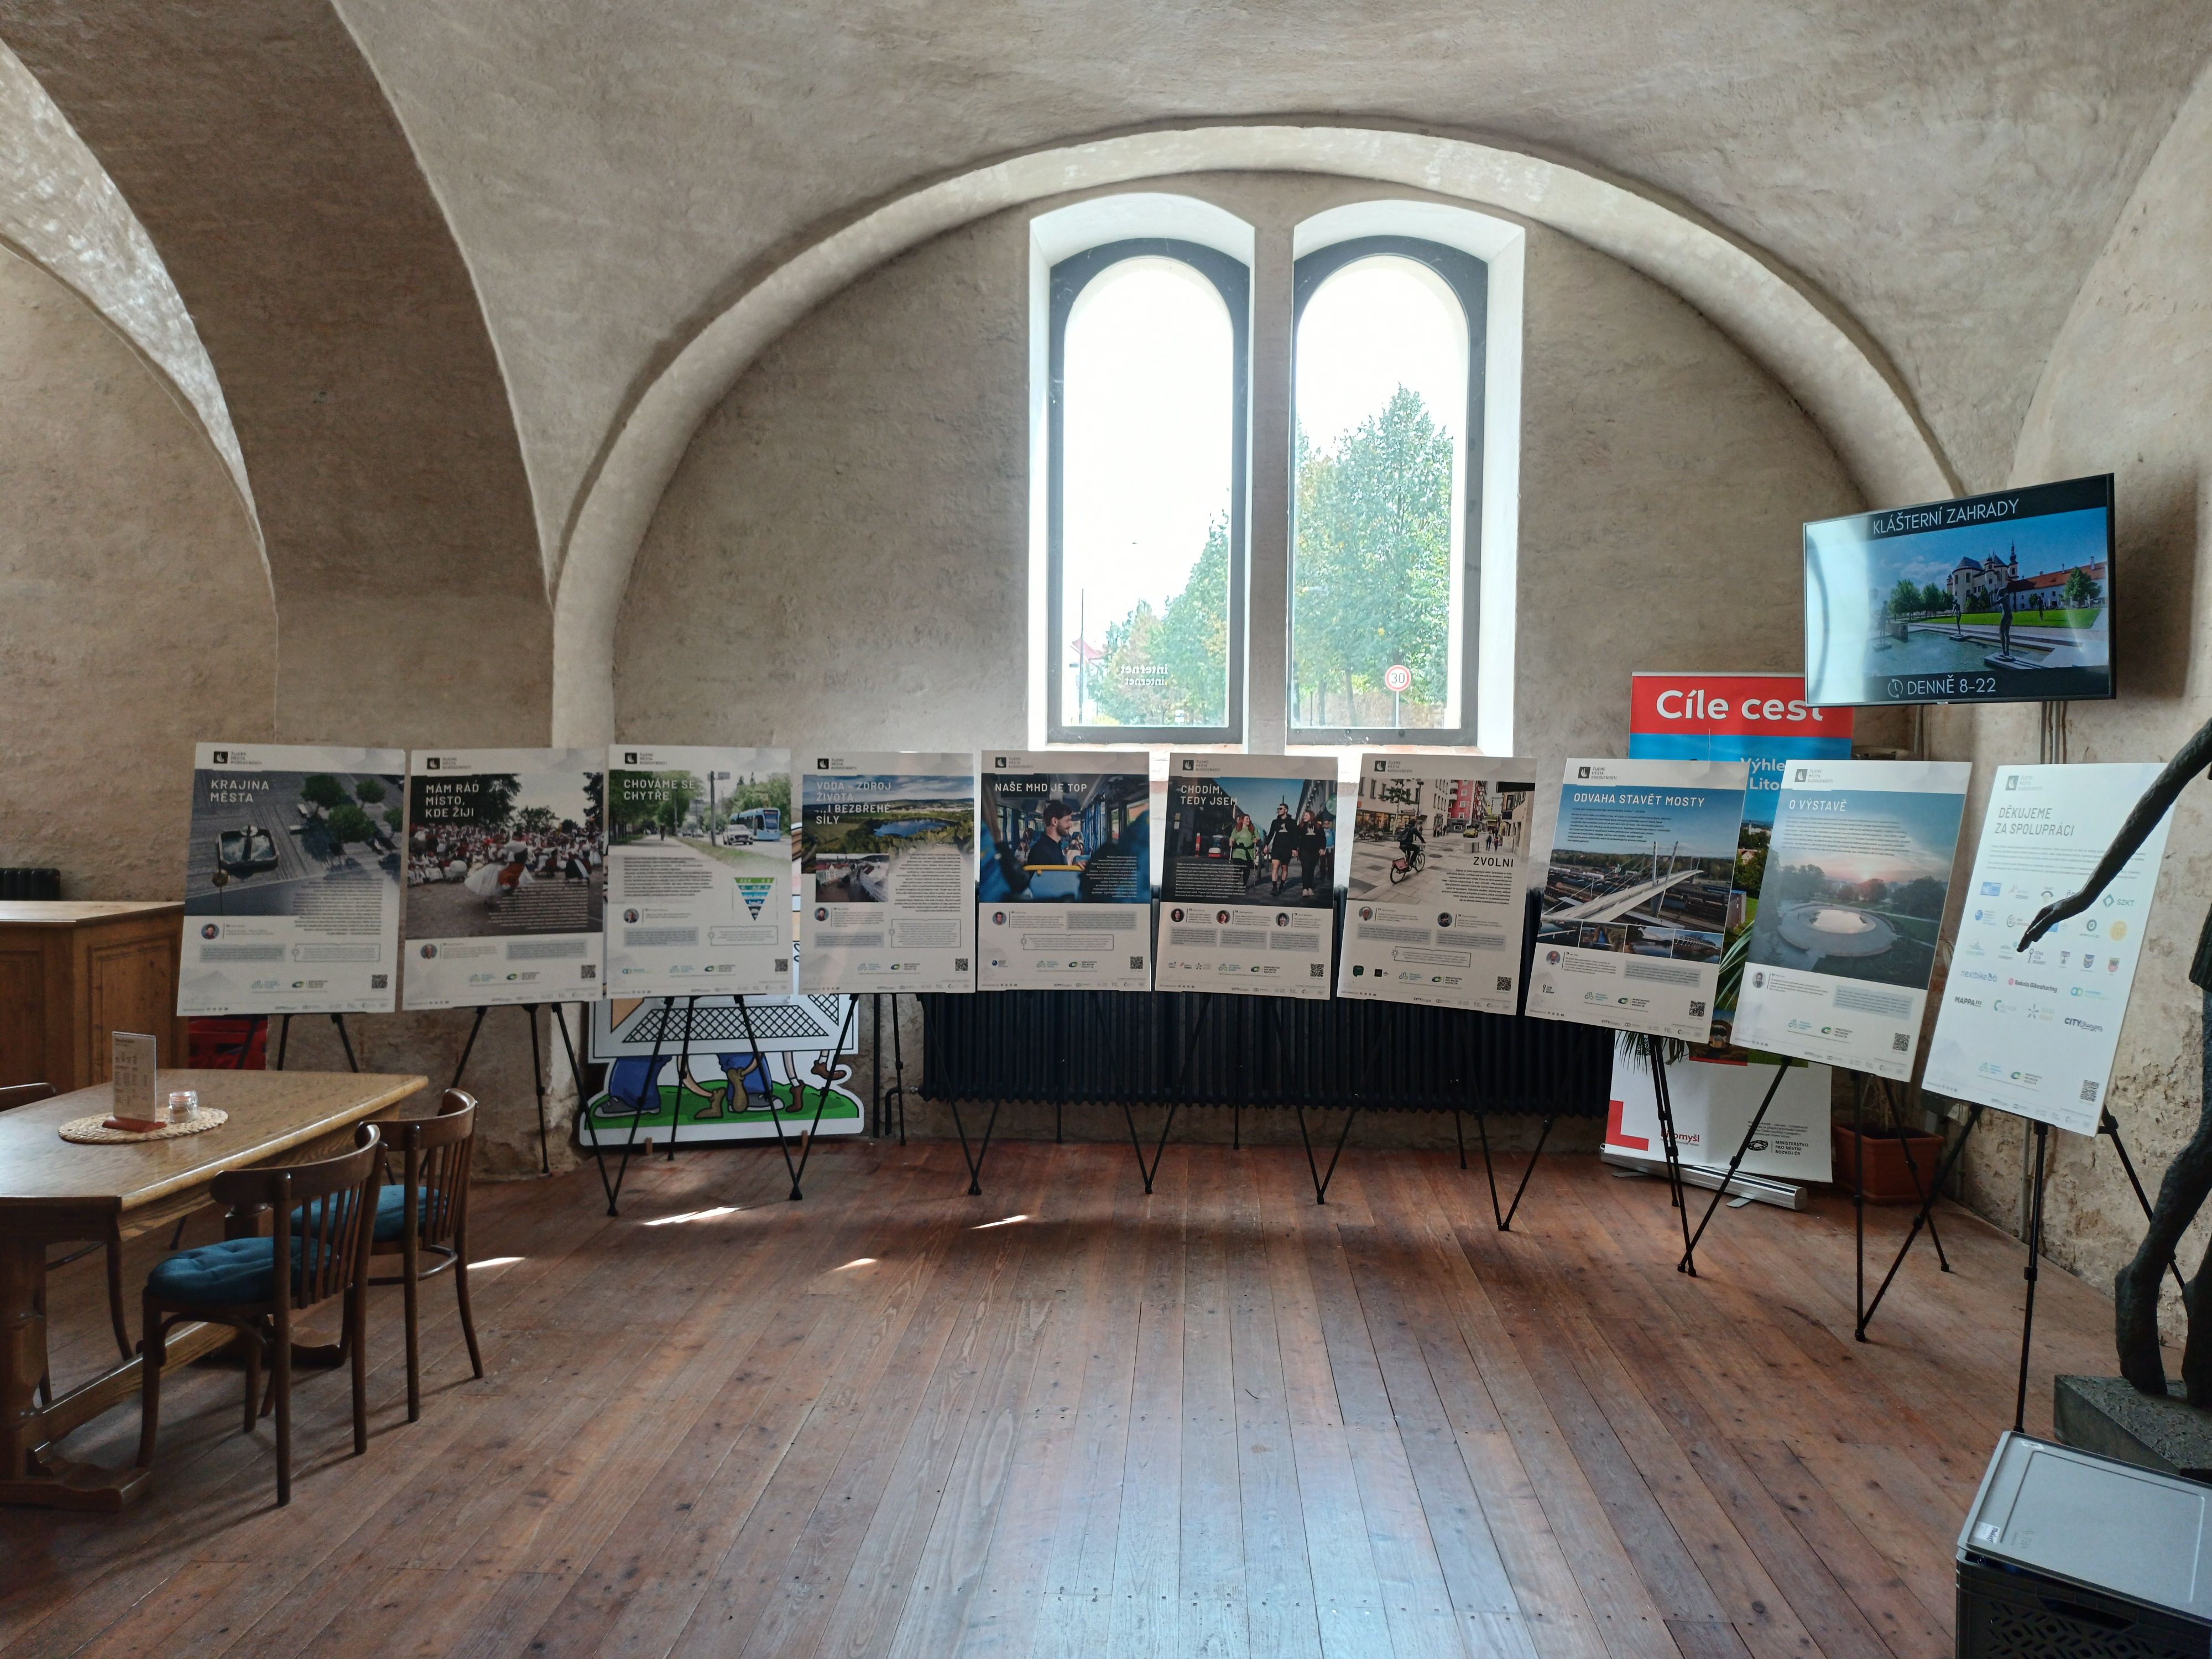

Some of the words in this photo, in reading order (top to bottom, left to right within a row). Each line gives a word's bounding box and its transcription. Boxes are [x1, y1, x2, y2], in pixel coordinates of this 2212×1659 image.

[1874, 506, 1943, 535] KLÁŠTERNÍ
[1947, 498, 2019, 524] ZAHRADY
[1391, 672, 1405, 684] 30
[1908, 674, 1954, 695] DENNĚ
[1960, 677, 1996, 693] 8-22
[1656, 689, 1729, 719] Cíle
[1740, 758, 1785, 774] ýhle
[211, 779, 269, 790] KRAJINA
[426, 782, 451, 794] MÁM
[456, 781, 479, 793] RÁD
[624, 777, 677, 789] CHOVÁME
[681, 780, 696, 789] SE
[817, 781, 844, 790] VODA
[857, 781, 891, 791] ZDROJ
[995, 781, 1022, 792] NAŠE
[1026, 783, 1048, 792] MHD
[1051, 783, 1063, 792] JE
[1068, 783, 1087, 792] TOP
[1749, 778, 1782, 791] Lito
[624, 789, 669, 801] CHYTŘE
[1181, 784, 1223, 795] CHODÍM,
[210, 790, 253, 802] MĚSTA
[426, 794, 465, 806] MÍSTO,
[1181, 796, 1208, 805] TEDY
[1210, 796, 1238, 806] JSEM
[1574, 792, 1615, 804] ODVAHA
[1619, 793, 1662, 805] STAVĚT
[1665, 796, 1705, 807] MOSTY
[834, 802, 891, 813] BEZBŘEHÉ
[1789, 800, 1796, 810] O
[1799, 798, 1848, 811] VÝSTAVĚ
[425, 808, 449, 818] KDE
[452, 806, 474, 817] ŽIJI
[1999, 805, 2052, 819] DĚKUJEME
[816, 815, 839, 825] SÍLY
[1995, 823, 2006, 834] ZA
[2010, 822, 2074, 836] SPOLUPRÁCI
[1473, 856, 1514, 868] ZVOLNI
[1960, 971, 1987, 980] nextbike
[2030, 982, 2058, 993] Bikesharing
[1661, 1128, 1700, 1143] iomyšl
